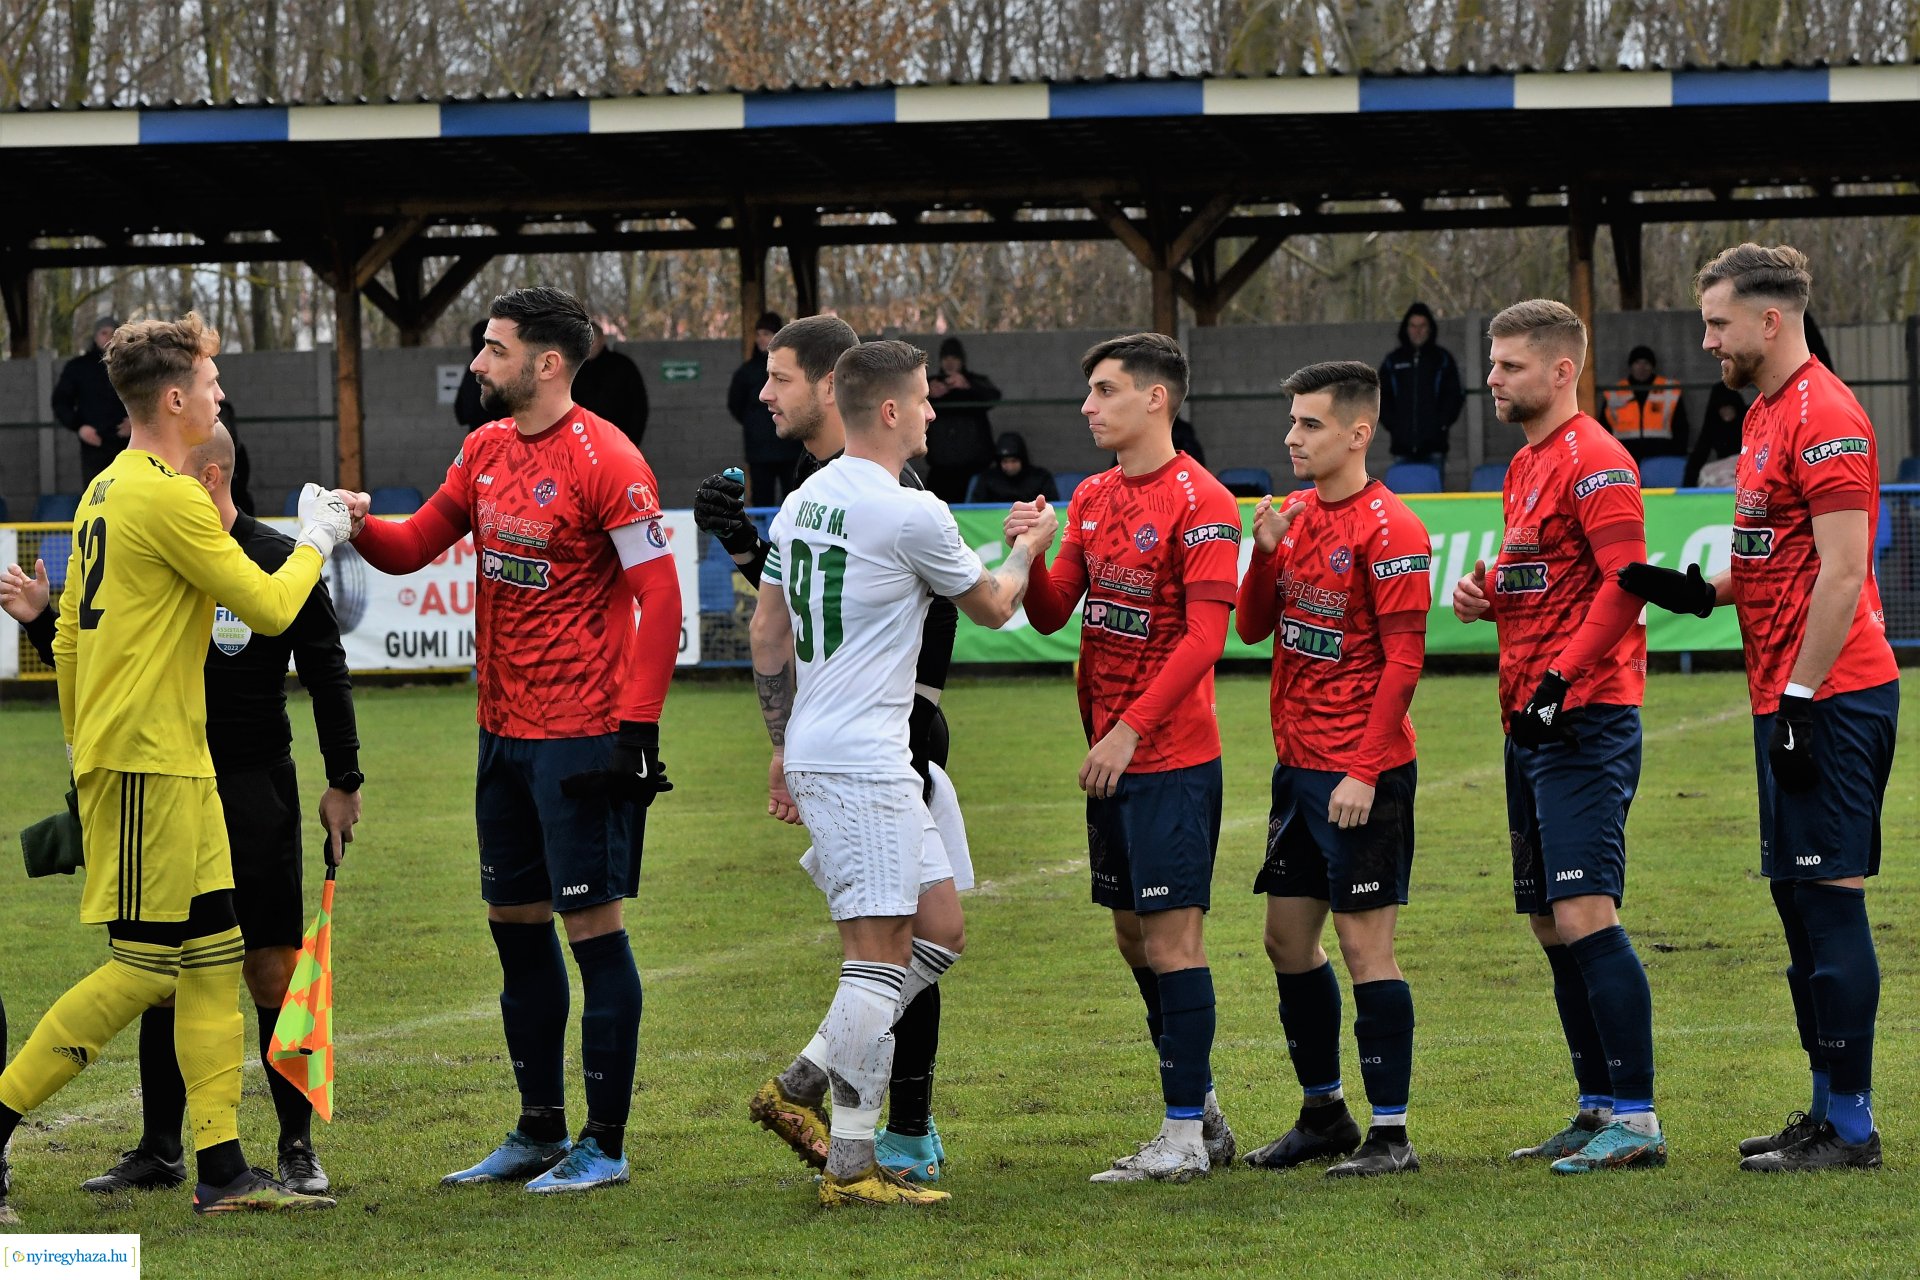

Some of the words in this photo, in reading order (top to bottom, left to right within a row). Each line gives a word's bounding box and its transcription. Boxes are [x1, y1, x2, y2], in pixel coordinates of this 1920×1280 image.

[795, 500, 827, 531] KISS
[827, 507, 848, 539] M.
[78, 516, 107, 630] 12
[789, 538, 848, 663] 91
[386, 630, 447, 658] GUMI
[1795, 855, 1822, 866] JAKO
[1555, 869, 1584, 882] JAKO
[562, 884, 589, 896] JAKO
[1141, 886, 1169, 898] JAKO
[1351, 881, 1380, 894] JAKO
[583, 1069, 603, 1080] AKO
